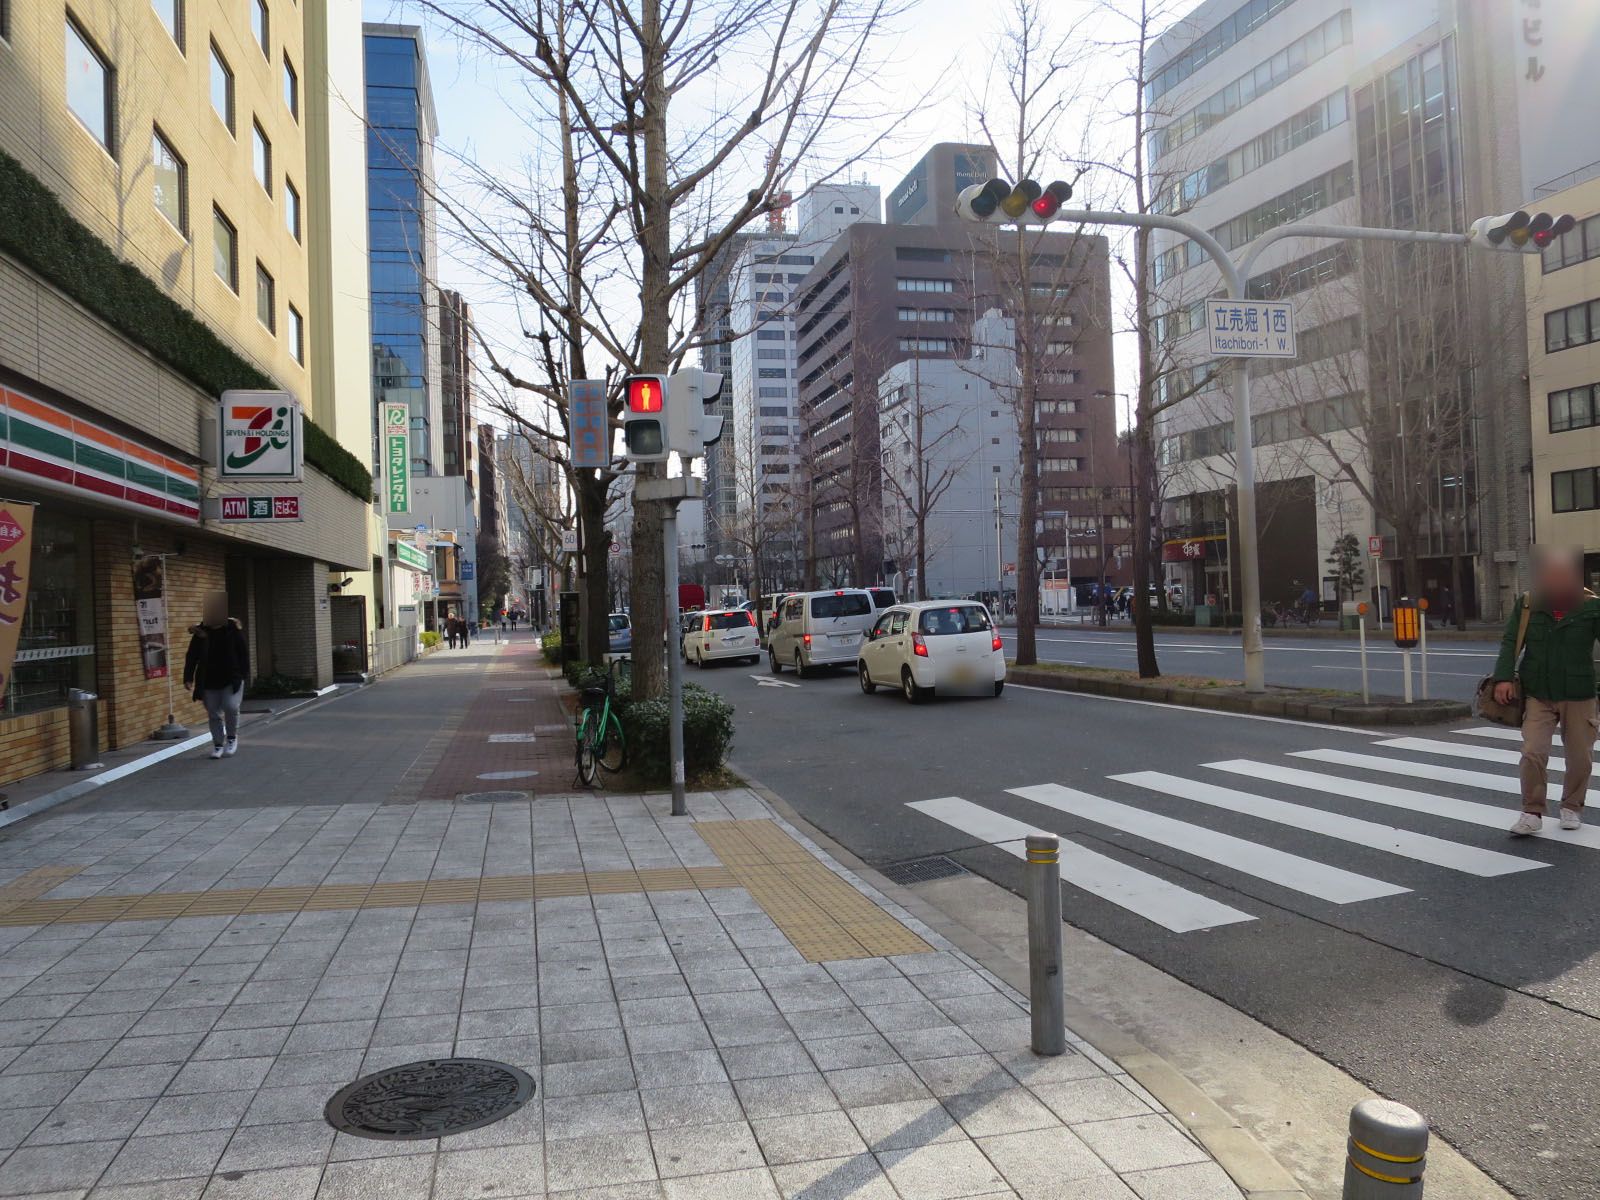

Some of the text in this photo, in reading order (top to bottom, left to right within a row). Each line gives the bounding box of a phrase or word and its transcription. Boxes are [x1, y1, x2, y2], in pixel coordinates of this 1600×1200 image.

[1215, 336, 1269, 350] Itachibori-1
[391, 438, 405, 511] トヨタレンタカー
[224, 501, 246, 516] ATM
[253, 500, 268, 515] 酒
[275, 500, 298, 515] たばこ
[565, 534, 575, 544] 60
